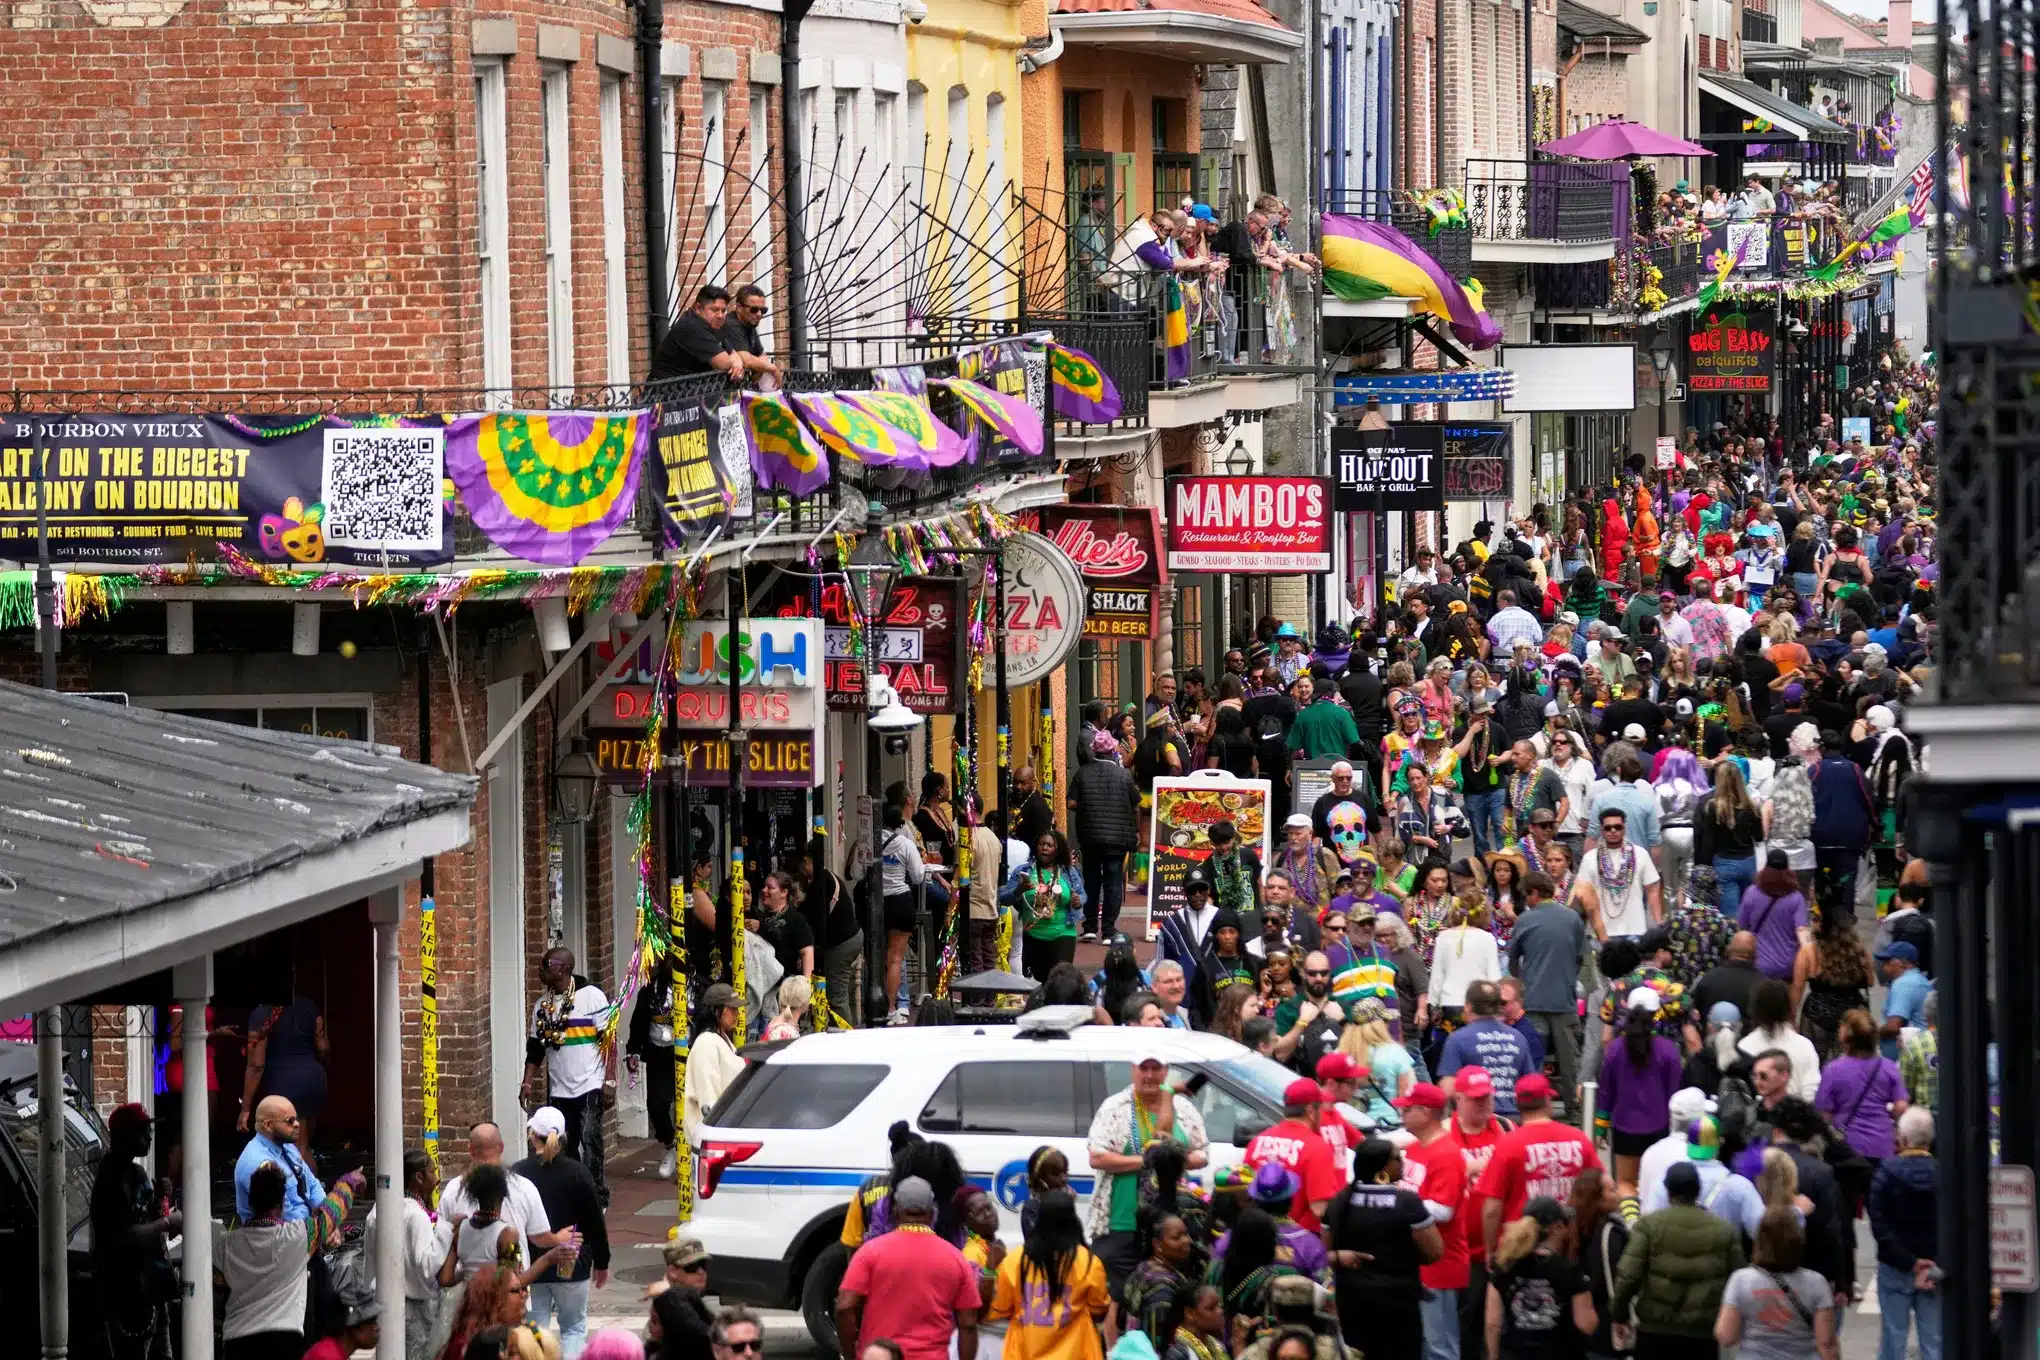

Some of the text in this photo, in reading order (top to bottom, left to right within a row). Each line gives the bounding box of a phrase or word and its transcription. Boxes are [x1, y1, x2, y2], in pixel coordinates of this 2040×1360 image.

[1690, 328, 1769, 351] BIG EASY
[1689, 377, 1768, 388] PIZZA BY THE SLICE
[132, 423, 203, 438] VIEUX
[59, 447, 89, 477] ON
[99, 447, 144, 477] THE
[152, 447, 251, 478] BIGGEST
[1388, 483, 1417, 492] GRILL
[94, 481, 125, 511] ON
[133, 481, 240, 511] BOURBON
[1176, 483, 1323, 529] MAMBO'S
[64, 526, 115, 538] RESTROOMS
[123, 525, 162, 538] GOURMET
[165, 525, 187, 537] FOOD
[196, 524, 213, 537] LIVE
[216, 526, 243, 538] MUSIC
[1181, 530, 1319, 546] Restaurant & Rooftop Bar
[57, 547, 164, 557] 501 BOURBON ST.
[1092, 592, 1148, 612] SHACK
[1111, 621, 1148, 635] BEER
[1026, 656, 1039, 667] LA
[615, 691, 790, 720] DAQURIS
[904, 695, 932, 706] COME
[749, 740, 811, 772] SLICE
[1156, 863, 1188, 873] WORLD
[1164, 873, 1186, 882] FAM
[1524, 1140, 1584, 1173] JESUS
